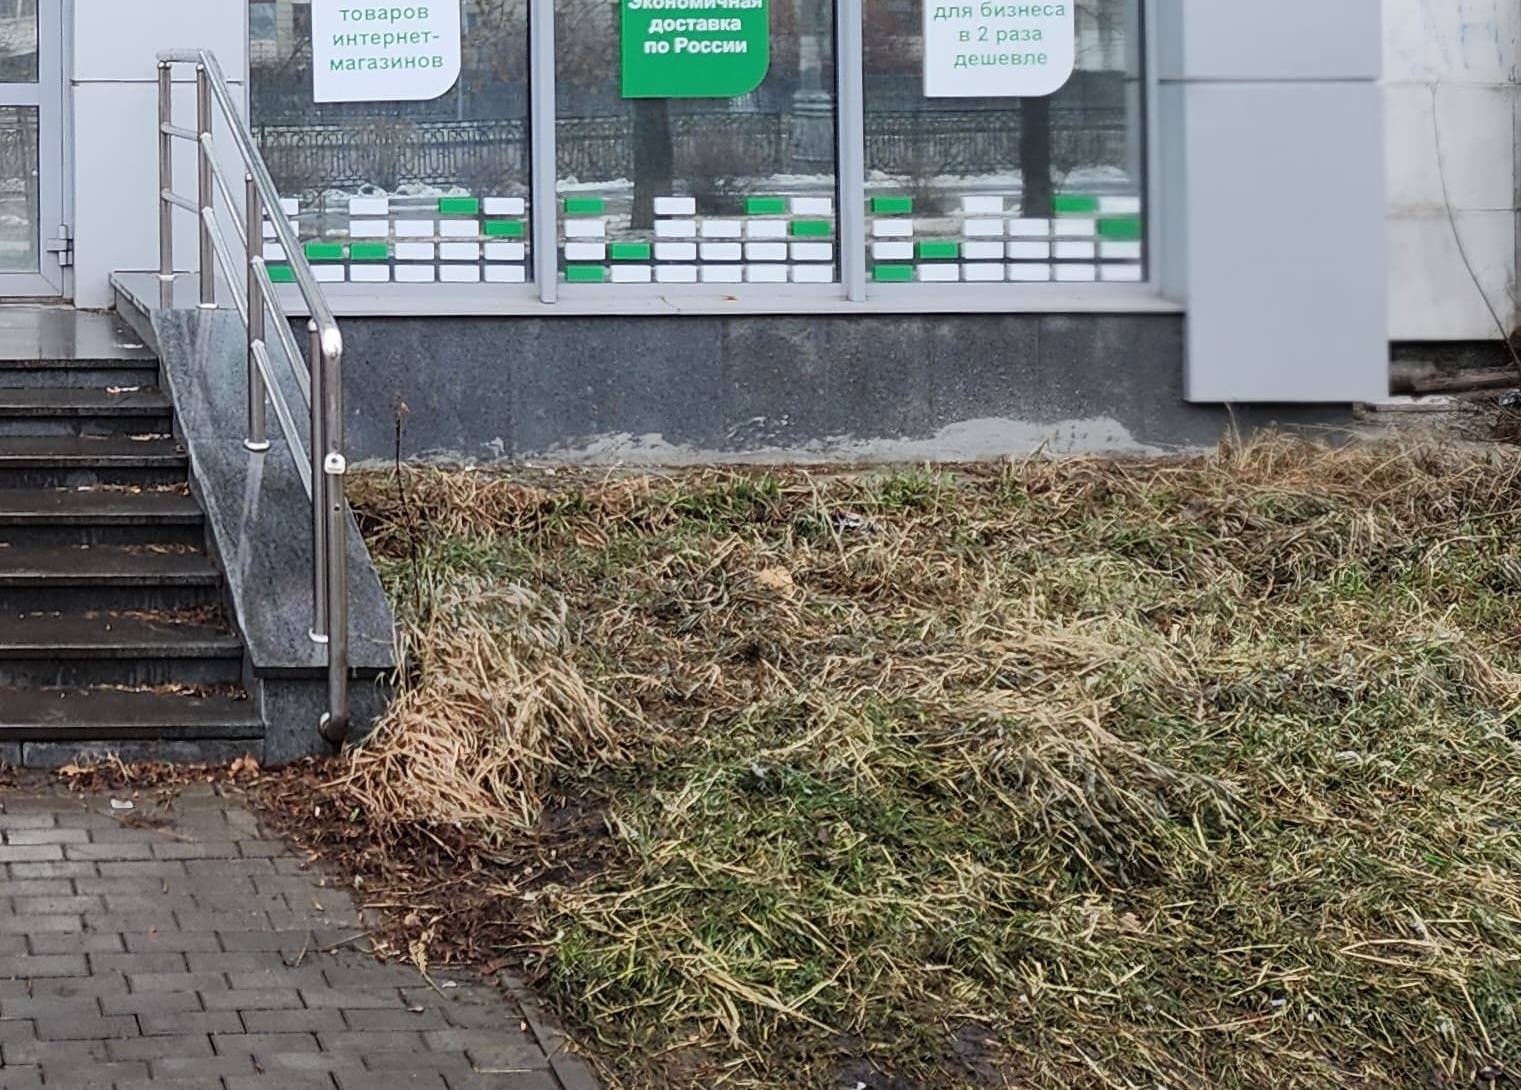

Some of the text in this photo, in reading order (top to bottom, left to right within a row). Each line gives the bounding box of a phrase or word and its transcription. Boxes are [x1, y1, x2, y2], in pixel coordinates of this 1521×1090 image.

[339, 6, 430, 24] товаров
[933, 1, 1065, 21] для бизнеса
[648, 17, 742, 34] доставка
[332, 30, 440, 49] интернет-
[959, 25, 1042, 44] в 2 раза
[643, 37, 747, 54] по России
[330, 55, 444, 71] магазинов
[954, 52, 1048, 69] дешевле
